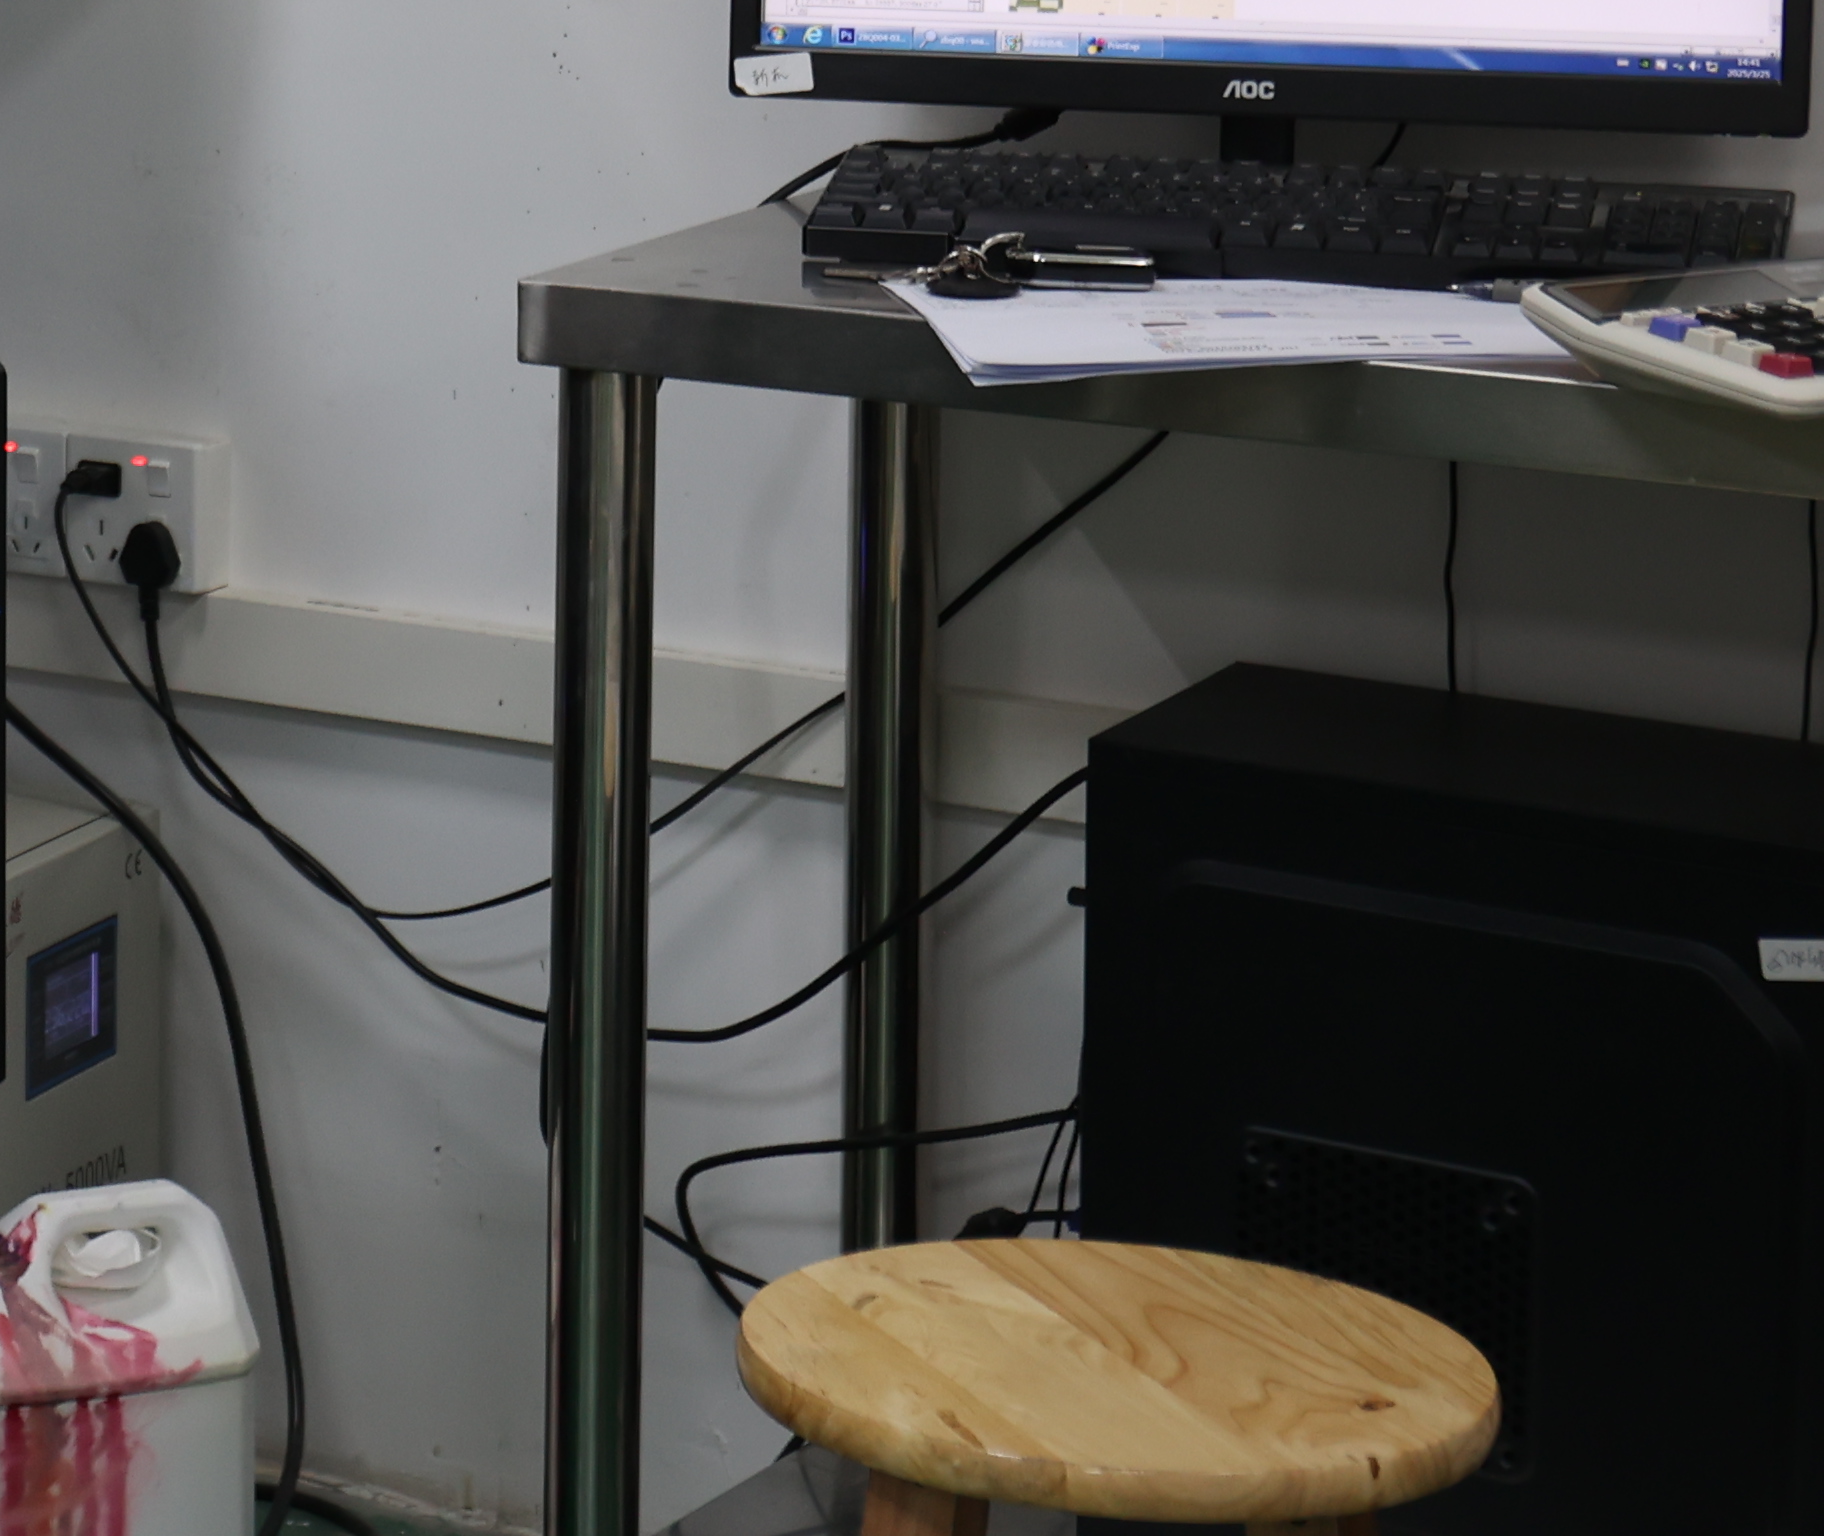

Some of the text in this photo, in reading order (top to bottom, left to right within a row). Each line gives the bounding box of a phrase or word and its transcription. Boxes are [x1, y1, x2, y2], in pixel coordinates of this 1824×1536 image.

[840, 30, 853, 42] Ps
[1222, 79, 1275, 100] AOC
[66, 1145, 127, 1191] 5000VA
